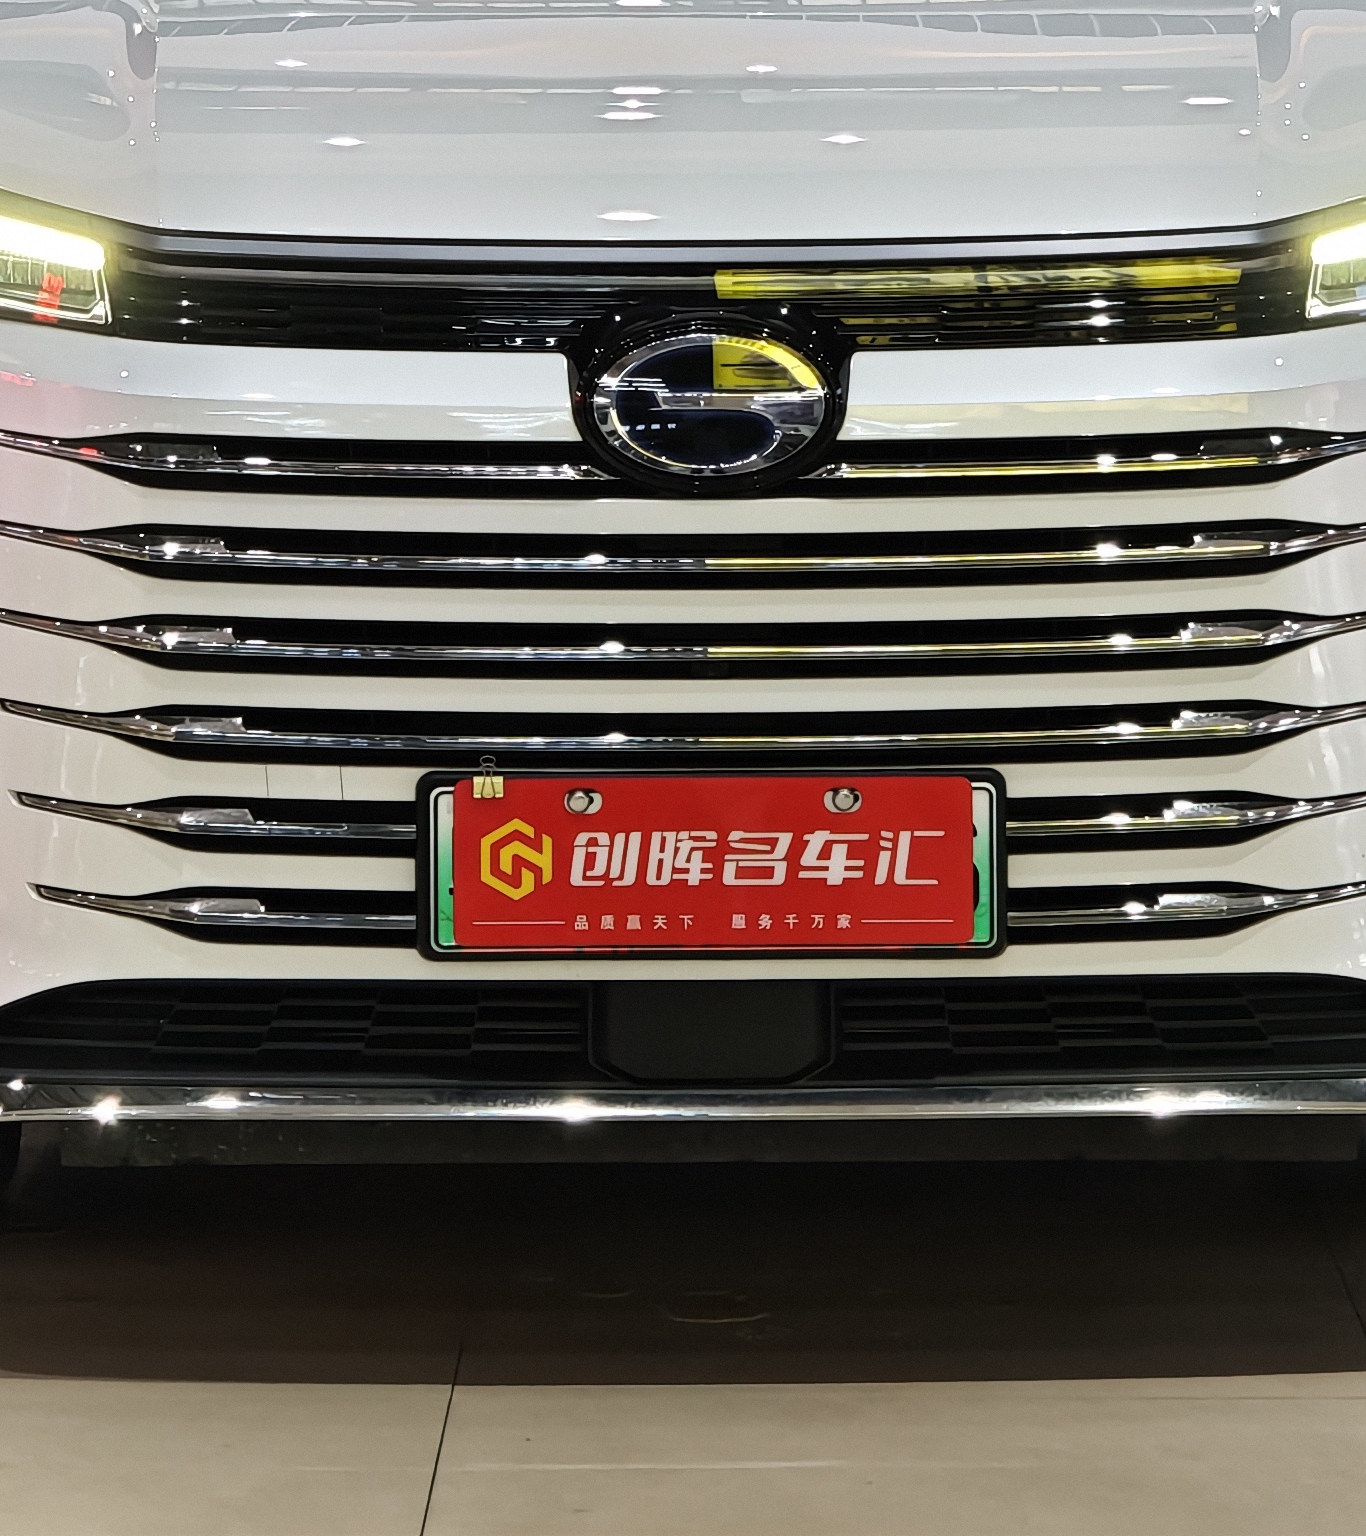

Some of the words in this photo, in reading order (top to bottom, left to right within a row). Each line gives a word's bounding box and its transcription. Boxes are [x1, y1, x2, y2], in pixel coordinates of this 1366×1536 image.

[568, 829, 946, 887] 创晖名车汇
[731, 913, 852, 930] 服务千万家
